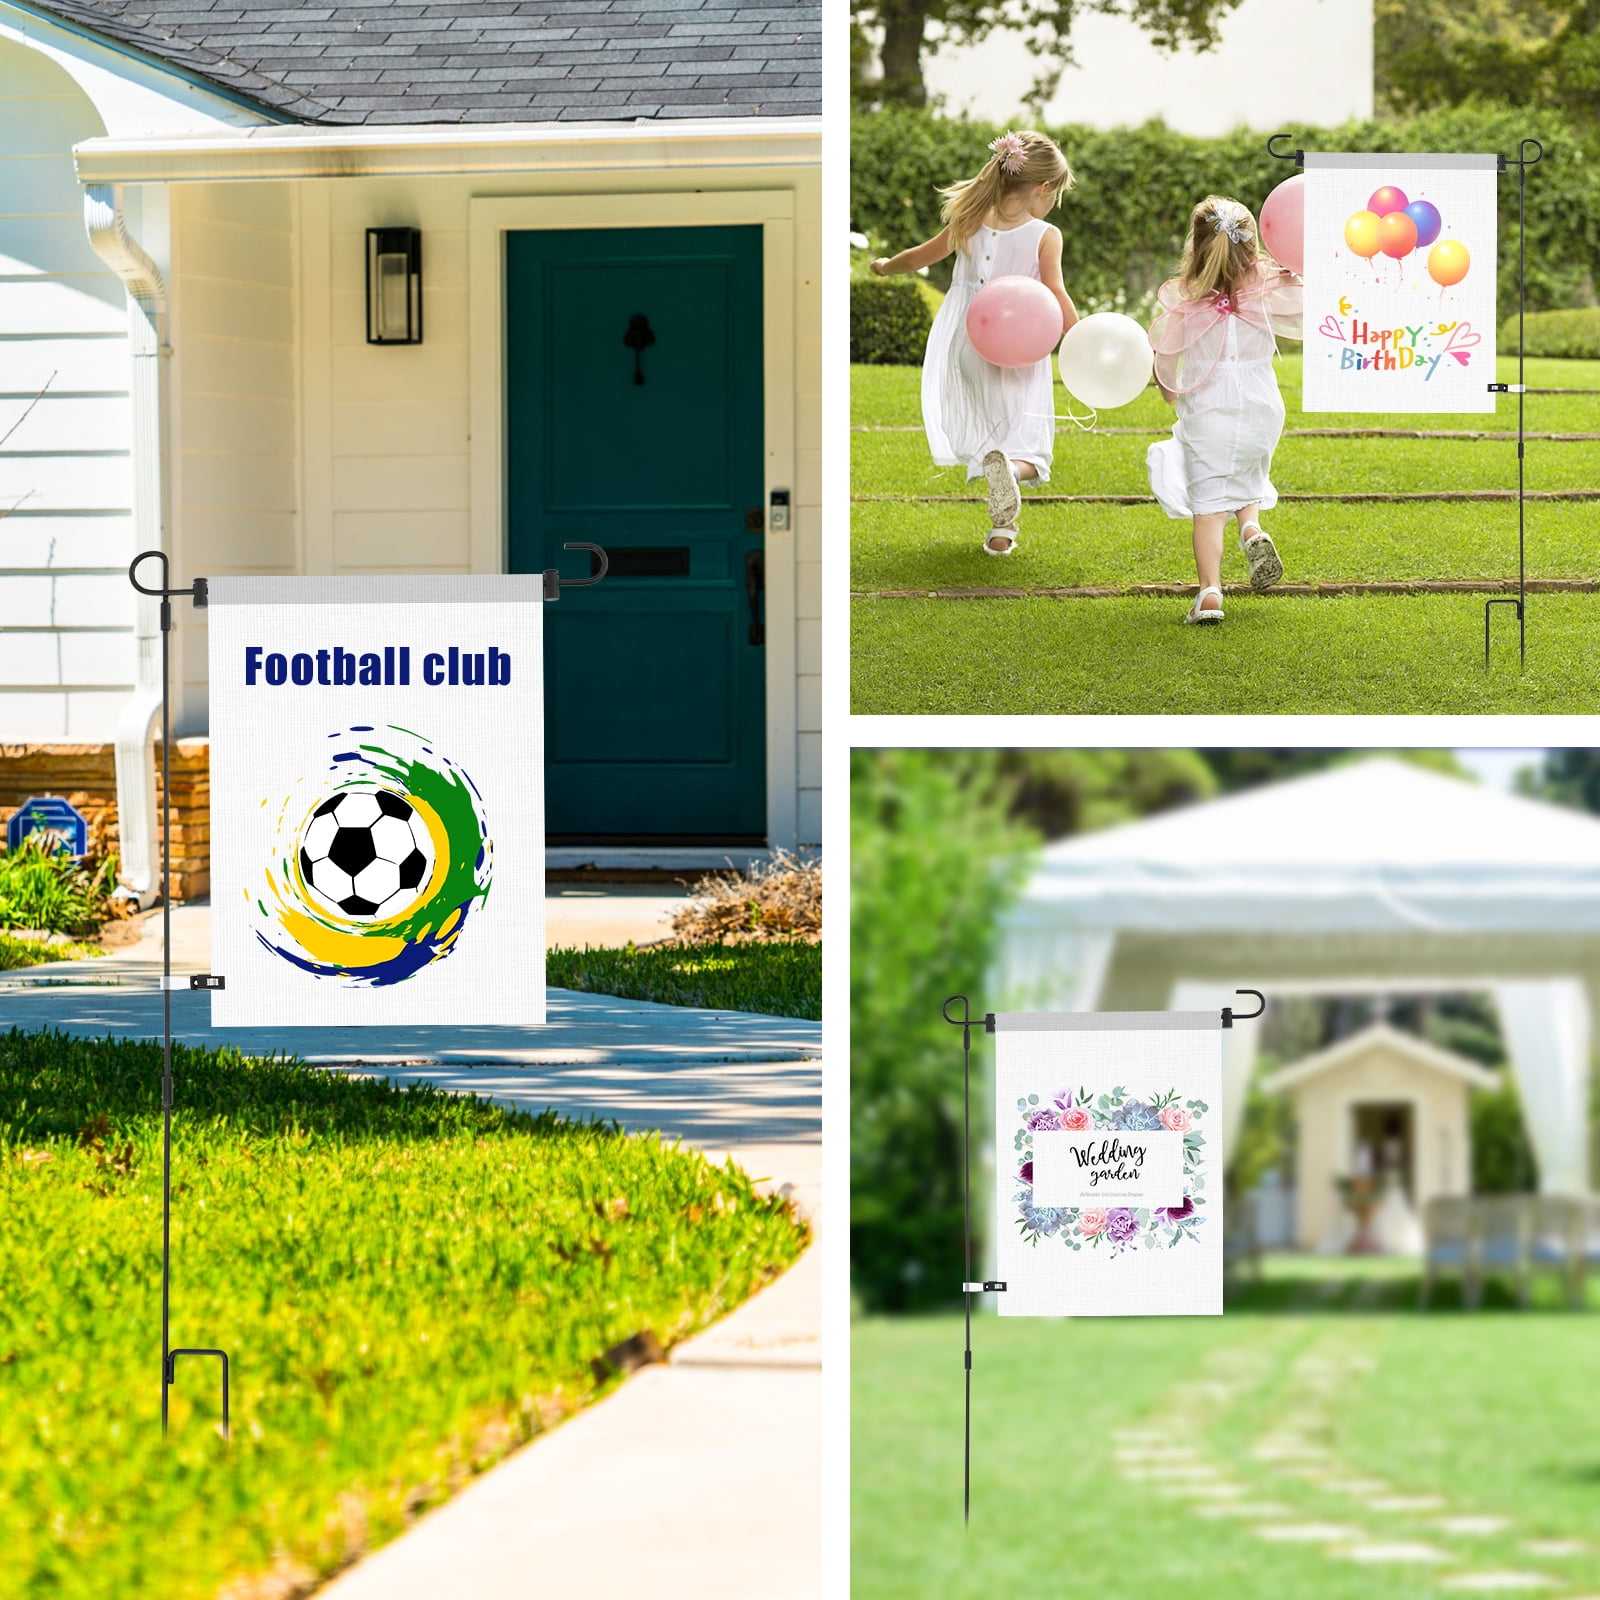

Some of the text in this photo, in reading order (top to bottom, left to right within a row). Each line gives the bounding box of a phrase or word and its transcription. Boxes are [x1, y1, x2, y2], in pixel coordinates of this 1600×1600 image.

[1340, 347, 1442, 381] BirthDay
[245, 646, 511, 686] Football club
[1069, 1138, 1147, 1168] Wedding
[1089, 1162, 1141, 1187] garden
